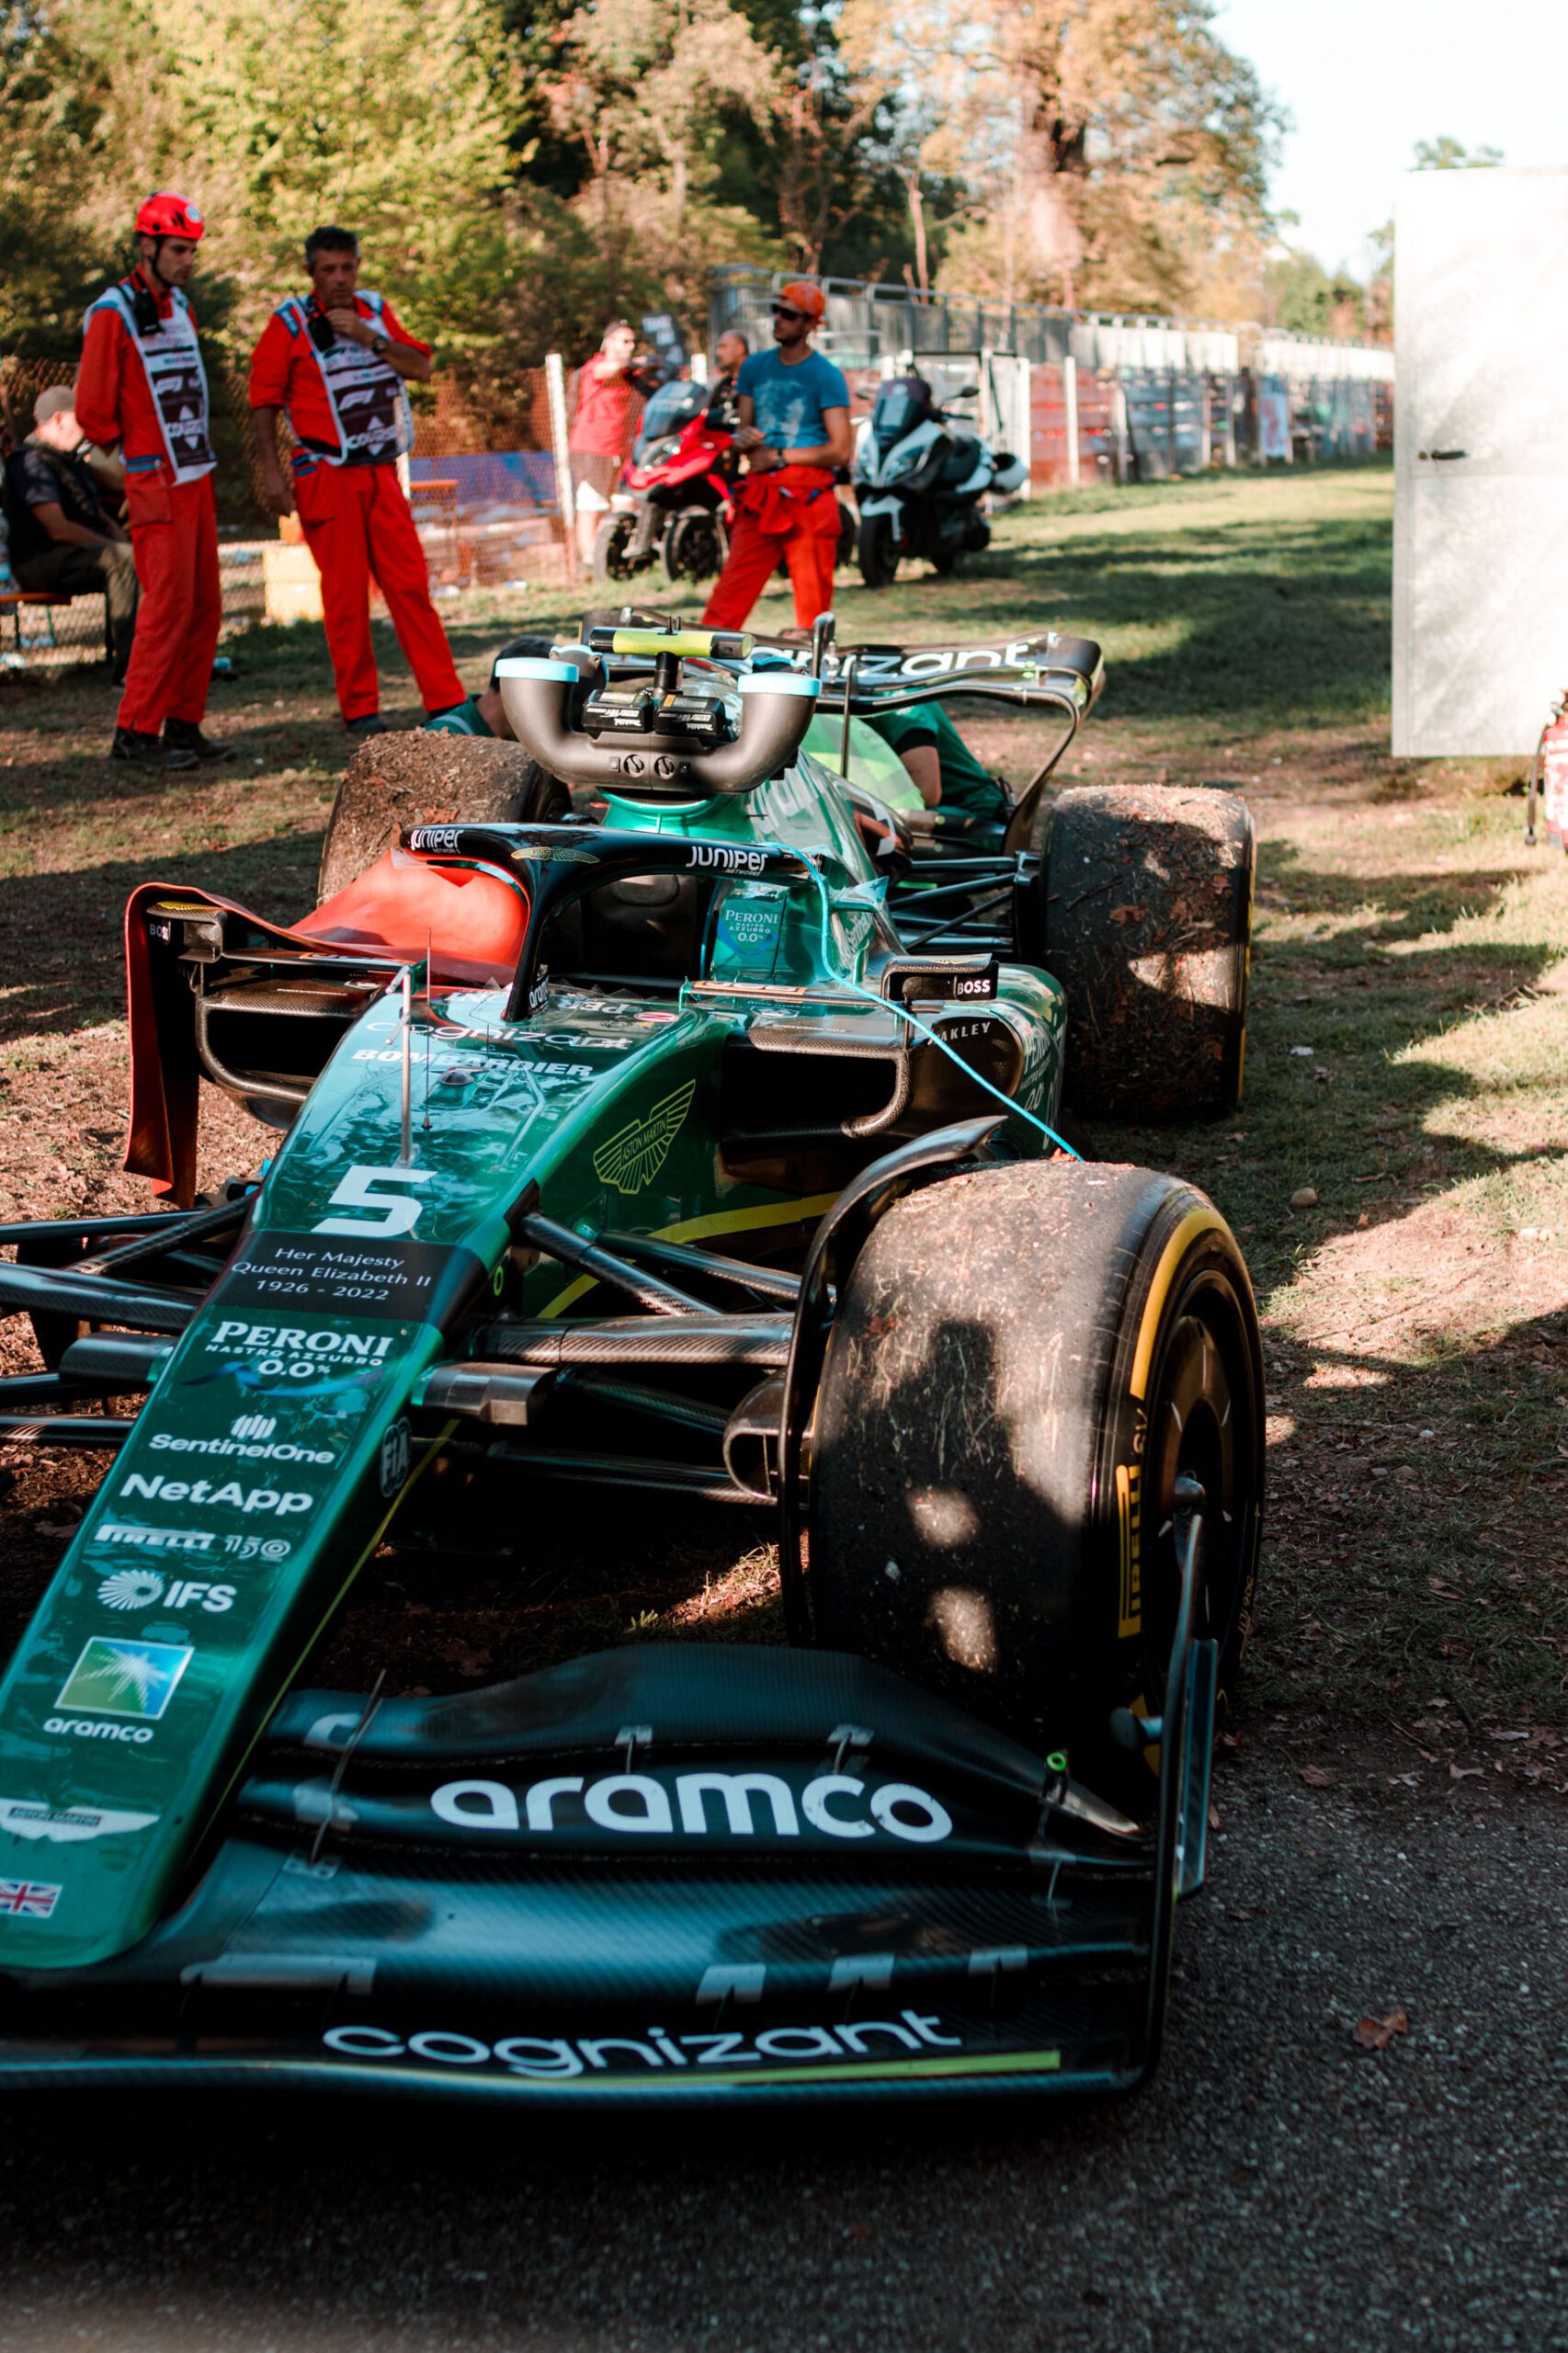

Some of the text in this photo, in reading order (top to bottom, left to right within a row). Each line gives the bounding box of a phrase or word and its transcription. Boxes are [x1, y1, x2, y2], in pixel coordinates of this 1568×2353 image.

[724, 909, 780, 925] PERONI
[957, 980, 992, 995] BOSS
[366, 1021, 633, 1050] cognizant
[351, 1048, 595, 1077] BOMBARDIER
[311, 1164, 438, 1239] 5
[275, 1247, 404, 1268] Her Majesty
[231, 1261, 432, 1287] Queen Elizabeth II
[256, 1279, 309, 1294] 1926
[331, 1286, 390, 1301] 2022
[210, 1321, 394, 1357] PERONI
[205, 1344, 383, 1366] NASTRO AZZURRO
[149, 1434, 335, 1464] SentinelOne
[119, 1473, 313, 1518] NetApp
[94, 1523, 216, 1552] PIRELLI
[1115, 1464, 1142, 1639] PIRELLI
[163, 1580, 237, 1613] IFS
[42, 1715, 154, 1744] aramco
[430, 1772, 953, 1844] aramco
[323, 2009, 962, 2079] cognizant
